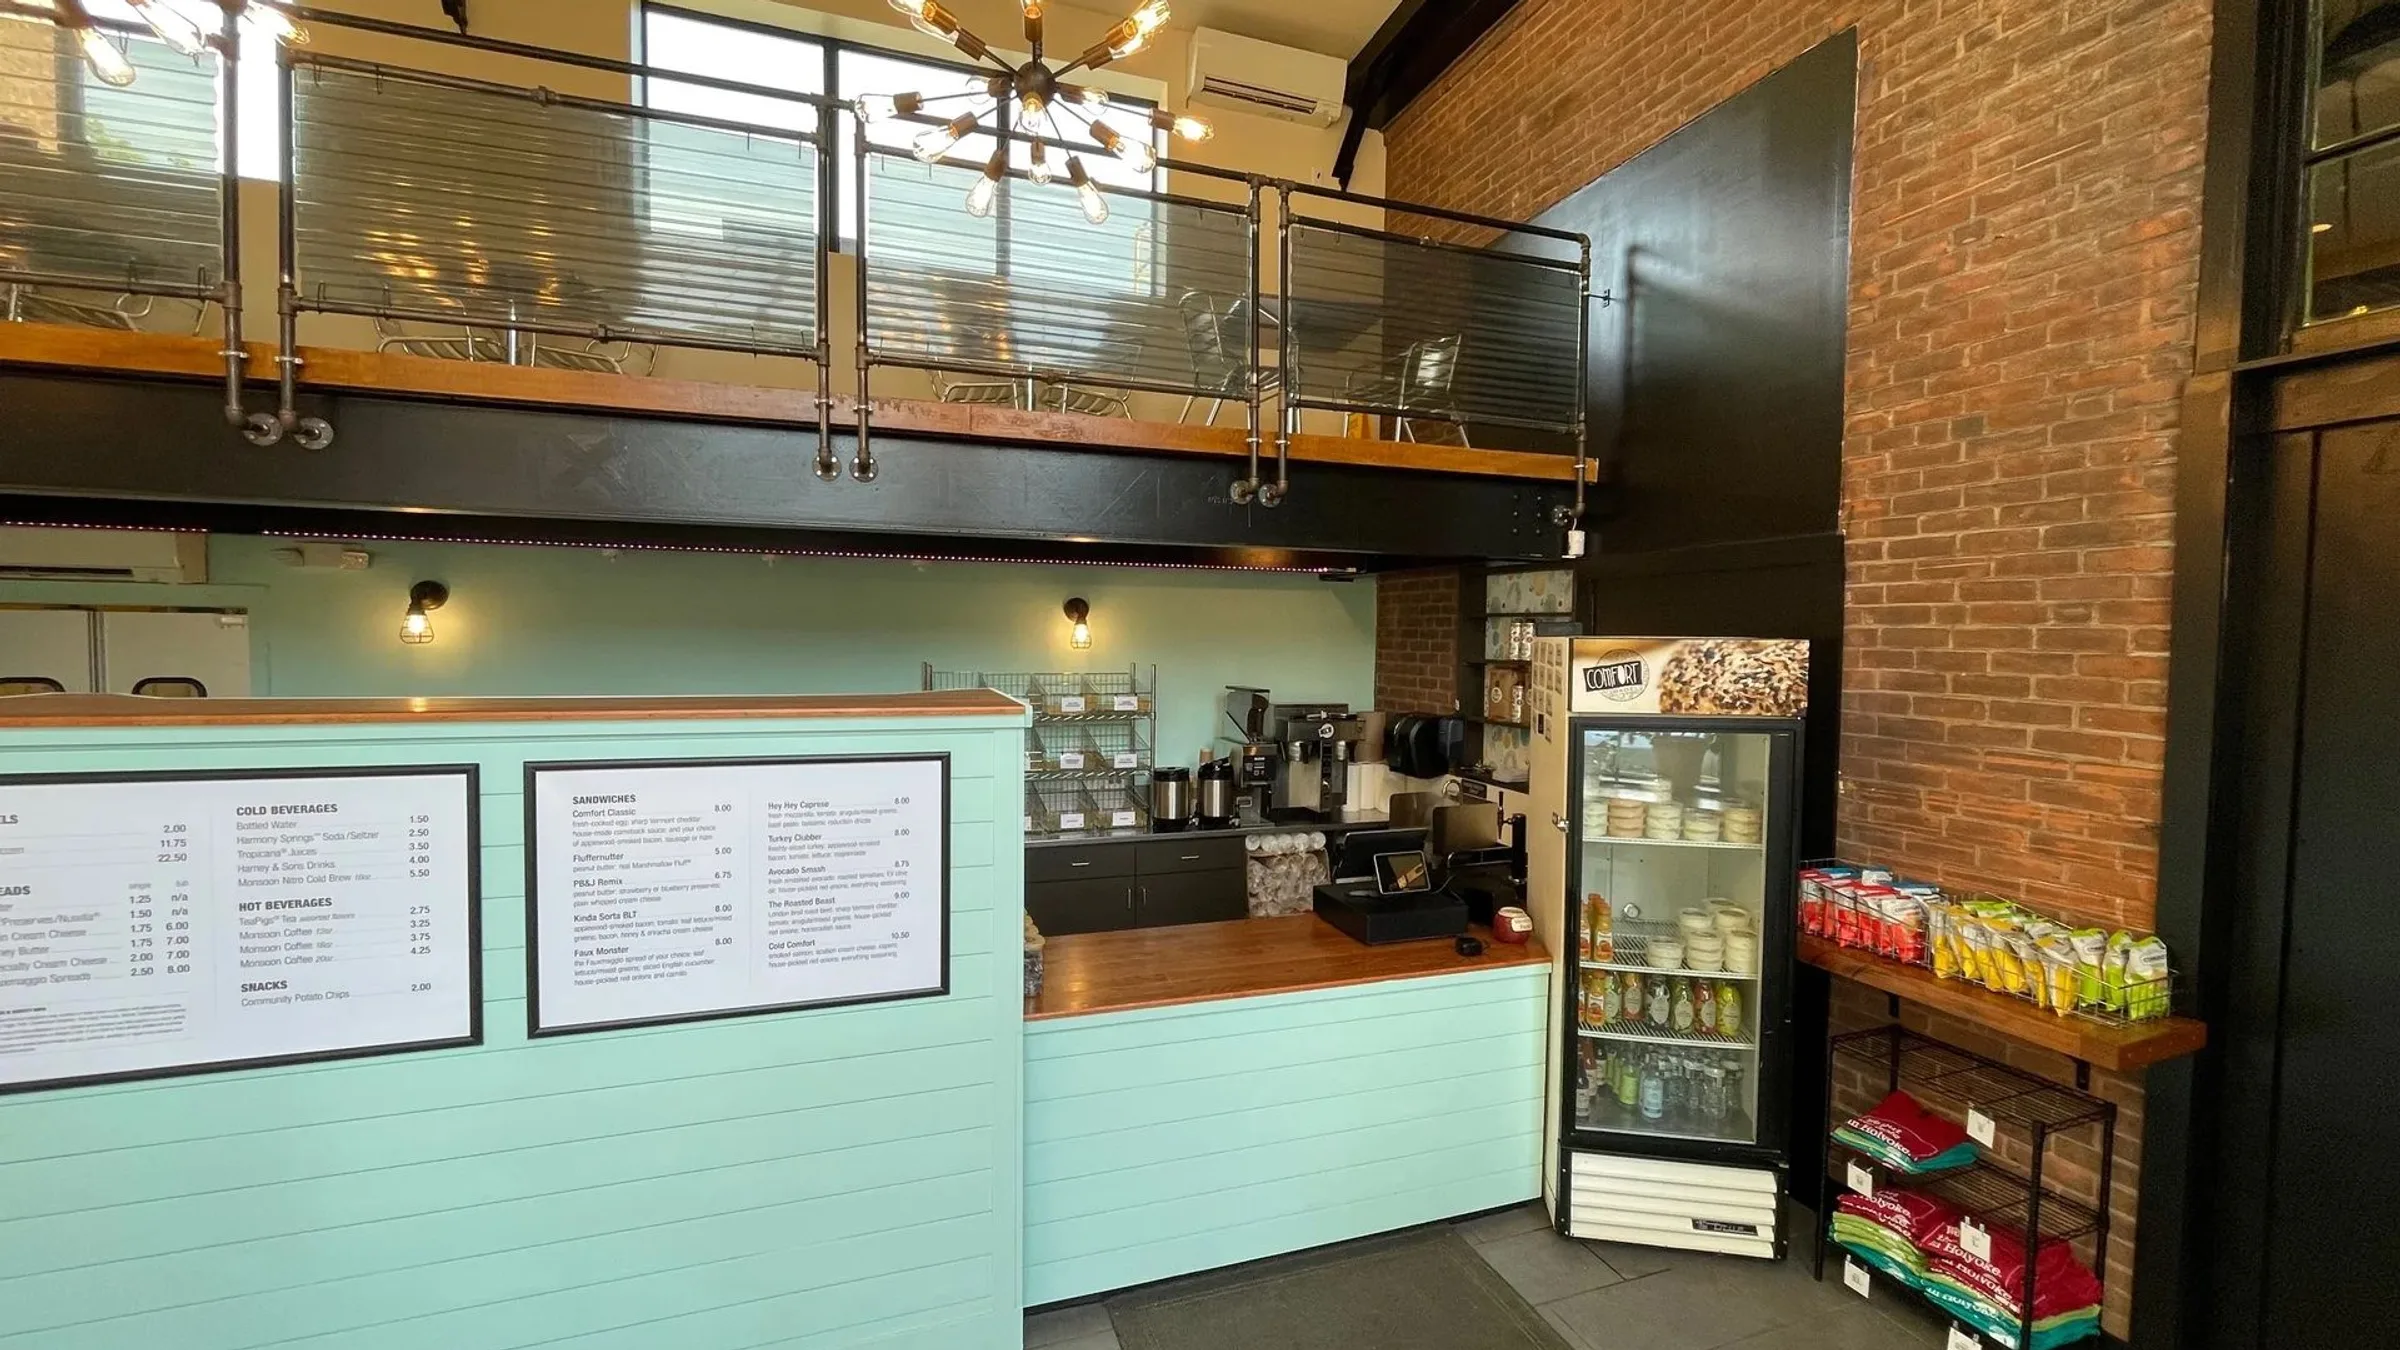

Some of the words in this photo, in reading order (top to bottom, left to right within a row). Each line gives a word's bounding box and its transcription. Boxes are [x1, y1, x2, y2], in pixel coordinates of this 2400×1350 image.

[1587, 663, 1639, 689] COMFORT
[573, 794, 636, 805] SANDWICHES
[768, 802, 782, 810] Hey
[784, 801, 798, 810] Hey
[800, 801, 829, 809] Caprese
[237, 806, 267, 816] COLD
[271, 804, 338, 815] BEVERAGES
[573, 809, 605, 818] Comfort
[608, 808, 636, 816] Classic
[714, 804, 732, 812] 8.00
[163, 825, 186, 833] 2.00
[237, 822, 268, 831] Bottled
[160, 839, 186, 847] 11.75
[237, 835, 277, 845] Harmony
[409, 829, 429, 837] 2.50
[768, 835, 792, 843] Turkey
[288, 848, 317, 857] Juices
[409, 842, 429, 850] 3.50
[158, 854, 187, 862] 22.50
[573, 853, 624, 863] Fluffernutter
[238, 864, 269, 874] Harney
[282, 862, 304, 871] Sons
[307, 860, 335, 870] Drinks
[409, 856, 430, 864] 4.00
[768, 867, 799, 876] Avocado
[238, 877, 280, 887] Monsoon
[282, 875, 303, 884] Nitro
[306, 874, 326, 884] Cold
[329, 873, 352, 882] Brew
[409, 869, 429, 877] 5.50
[130, 896, 151, 904] 1.25
[239, 902, 260, 912] HOT
[265, 898, 332, 910] BEVERAGES
[784, 899, 814, 907] Roasted
[130, 910, 152, 918] 1.50
[282, 915, 296, 924] Tea
[410, 906, 430, 914] 2.75
[574, 914, 598, 923] Kinda
[600, 913, 620, 921] Sorta
[623, 911, 636, 919] BLT
[130, 924, 152, 933] 1.75
[166, 922, 189, 931] 6.00
[240, 931, 281, 940] Monsoon
[284, 928, 312, 938] Coffee
[410, 919, 430, 928] 3.25
[131, 939, 152, 947] 1.75
[167, 937, 189, 945] 7.00
[240, 944, 281, 954] Monsoon
[284, 942, 313, 951] Coffee
[411, 933, 431, 942] 3.75
[574, 949, 594, 957] Faux
[596, 947, 629, 955] Monster
[715, 937, 732, 945] 8.00
[787, 940, 815, 948] Comfort
[130, 953, 153, 962] 2.00
[167, 951, 190, 959] 7.00
[240, 958, 282, 968] Monsoon
[284, 955, 313, 965] Coffee
[411, 946, 431, 955] 4.25
[131, 968, 153, 977] 2.50
[167, 965, 190, 974] 8.00
[241, 980, 288, 993] SNACKS
[241, 996, 292, 1007] Community
[295, 993, 323, 1002] Potato
[325, 990, 349, 1000] Chips
[411, 983, 431, 992] 2.00
[1869, 1197, 1912, 1218] olyoke.
